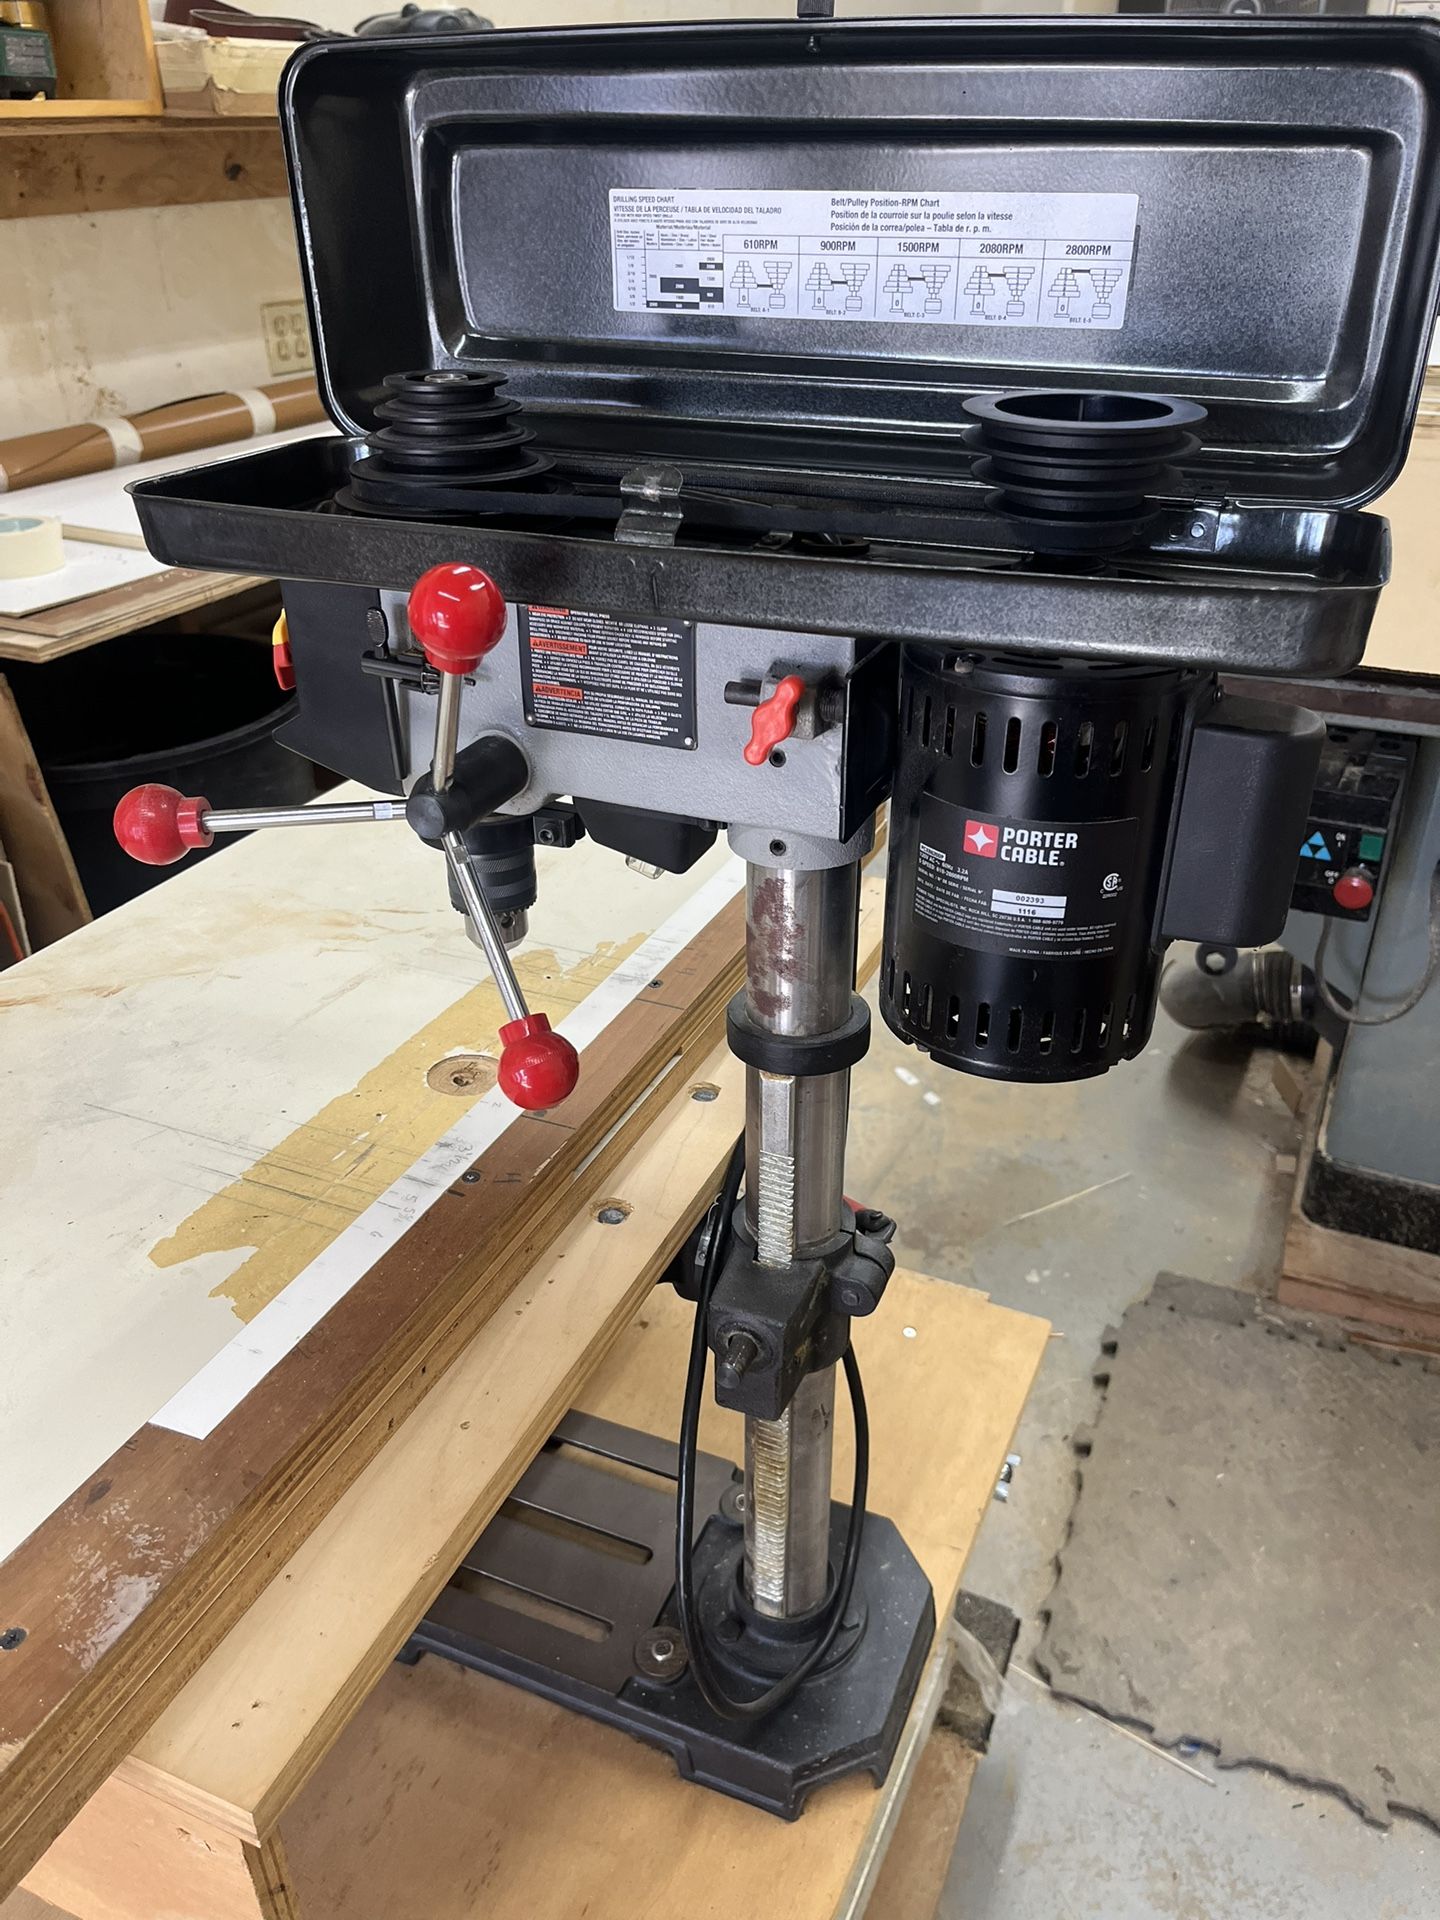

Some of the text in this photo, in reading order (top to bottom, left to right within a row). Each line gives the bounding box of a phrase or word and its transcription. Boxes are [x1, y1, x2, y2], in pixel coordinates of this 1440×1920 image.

[831, 198, 940, 208] Belt/Pulley Position-RPM Chart
[831, 211, 858, 219] Position
[860, 211, 869, 219] de
[871, 211, 877, 219] la
[879, 211, 909, 219] courroie
[923, 211, 930, 219] la
[932, 212, 955, 221] poulie
[956, 212, 976, 220] selon
[978, 212, 984, 220] la
[987, 212, 1013, 220] vitesse
[830, 222, 859, 231] Posición
[861, 223, 870, 231] de
[872, 223, 878, 231] la
[880, 223, 925, 233] correa/polea
[933, 224, 953, 232] Tabla
[955, 224, 964, 232] de
[743, 240, 778, 250] 610RPM
[820, 241, 856, 251] 900RPM
[898, 242, 940, 253] 1500RPM
[980, 243, 1024, 254] 2080RPM
[1065, 245, 1111, 255] 2800RPM
[538, 640, 586, 652] AVERTISSEMENT
[541, 685, 581, 697] ADVERTENCIA
[1003, 827, 1078, 849] PORTER
[1335, 832, 1346, 841] ON
[957, 867, 969, 875] 3.2A
[1016, 895, 1045, 904] 002393
